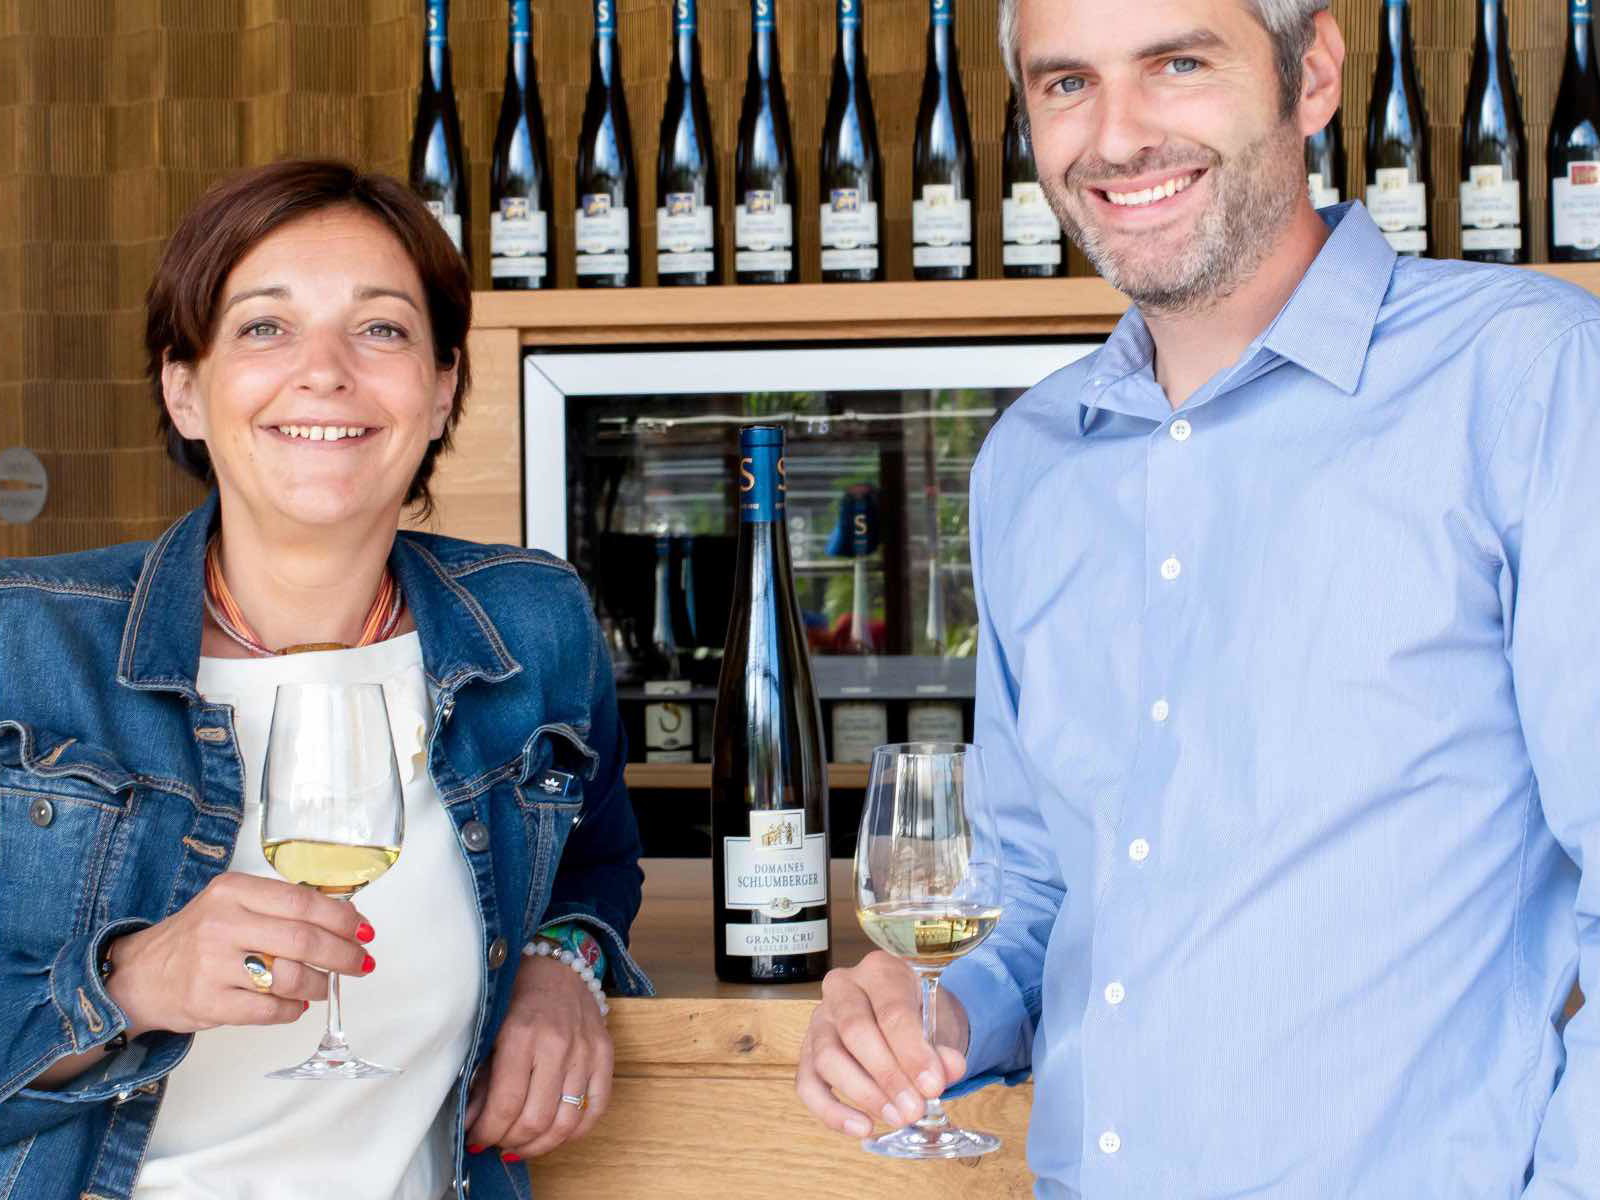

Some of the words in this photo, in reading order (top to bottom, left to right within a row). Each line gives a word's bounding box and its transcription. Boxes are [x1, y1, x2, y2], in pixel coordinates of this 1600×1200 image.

[598, 0, 609, 23] S
[740, 457, 755, 492] S
[854, 514, 867, 535] S
[754, 862, 805, 873] DOMAINES
[737, 873, 819, 888] SCHLUMBERGER
[745, 935, 788, 944] GRAND
[792, 931, 815, 943] CRU
